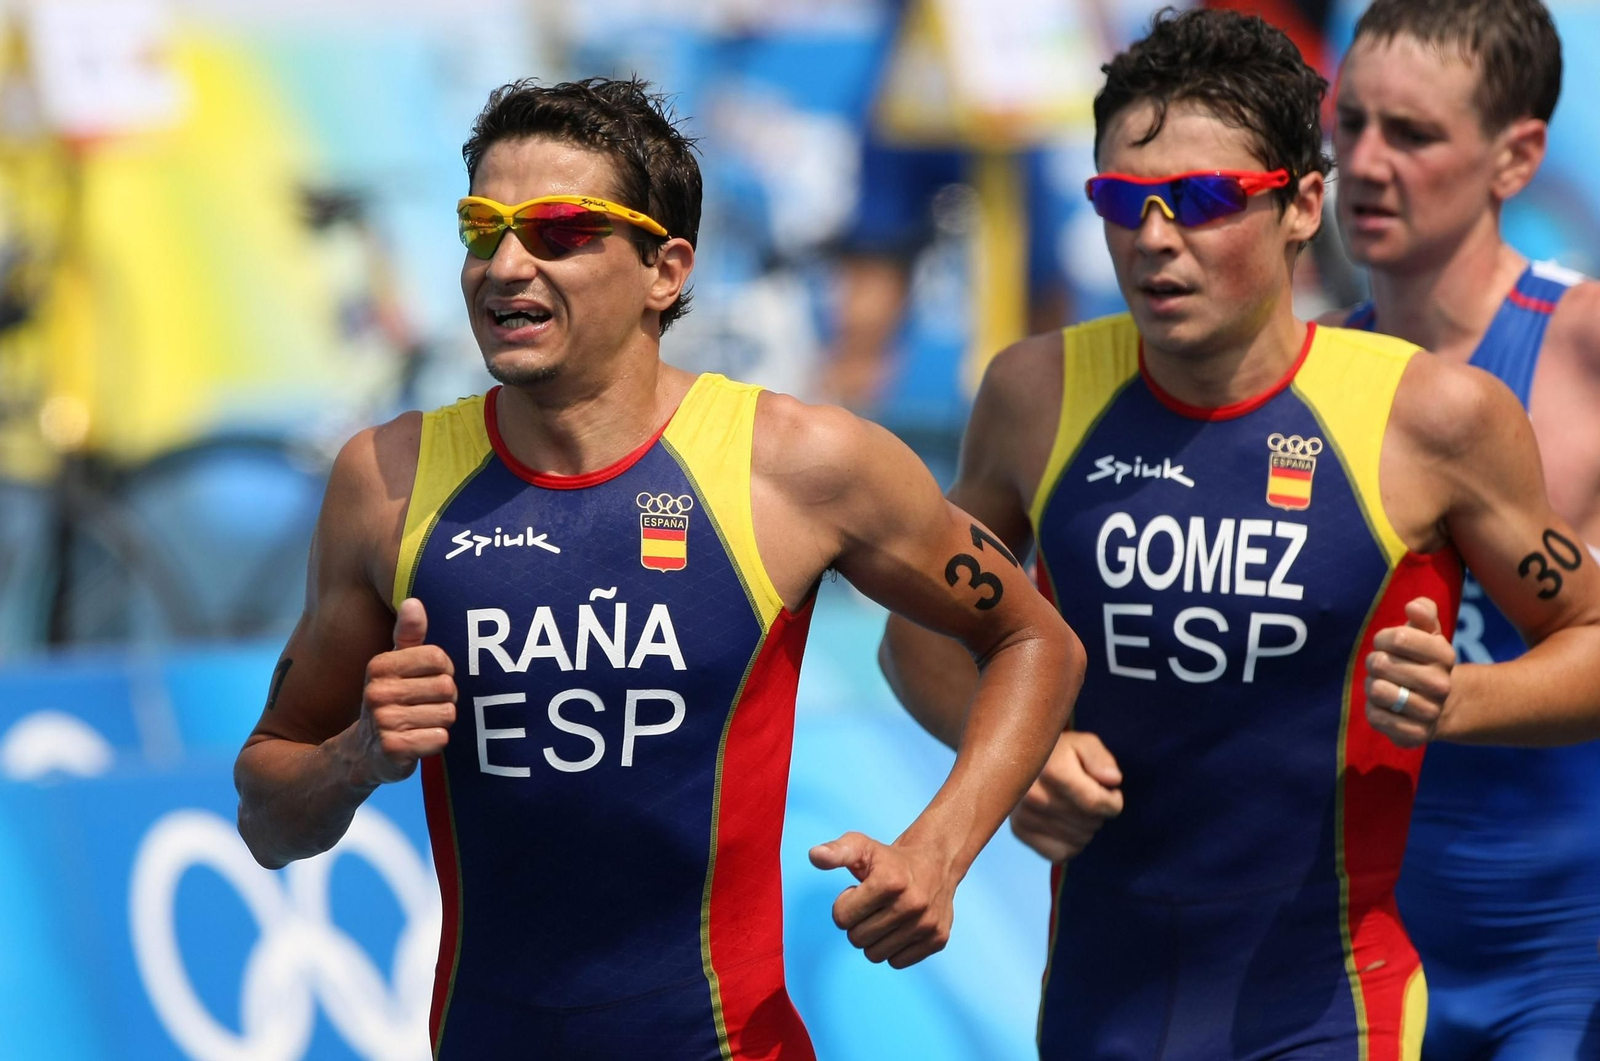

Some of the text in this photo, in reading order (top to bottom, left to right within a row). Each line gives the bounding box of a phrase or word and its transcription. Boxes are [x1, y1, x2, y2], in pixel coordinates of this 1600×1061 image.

[1086, 455, 1195, 488] Spiuk
[445, 526, 561, 560] Spiuk
[643, 517, 685, 529] ESPAÑA
[1096, 511, 1308, 601] GOMEZ
[944, 523, 1019, 611] 31
[1518, 528, 1582, 601] 30
[466, 586, 688, 676] RAÑA
[1103, 602, 1308, 683] ESP
[472, 688, 686, 778] ESP
